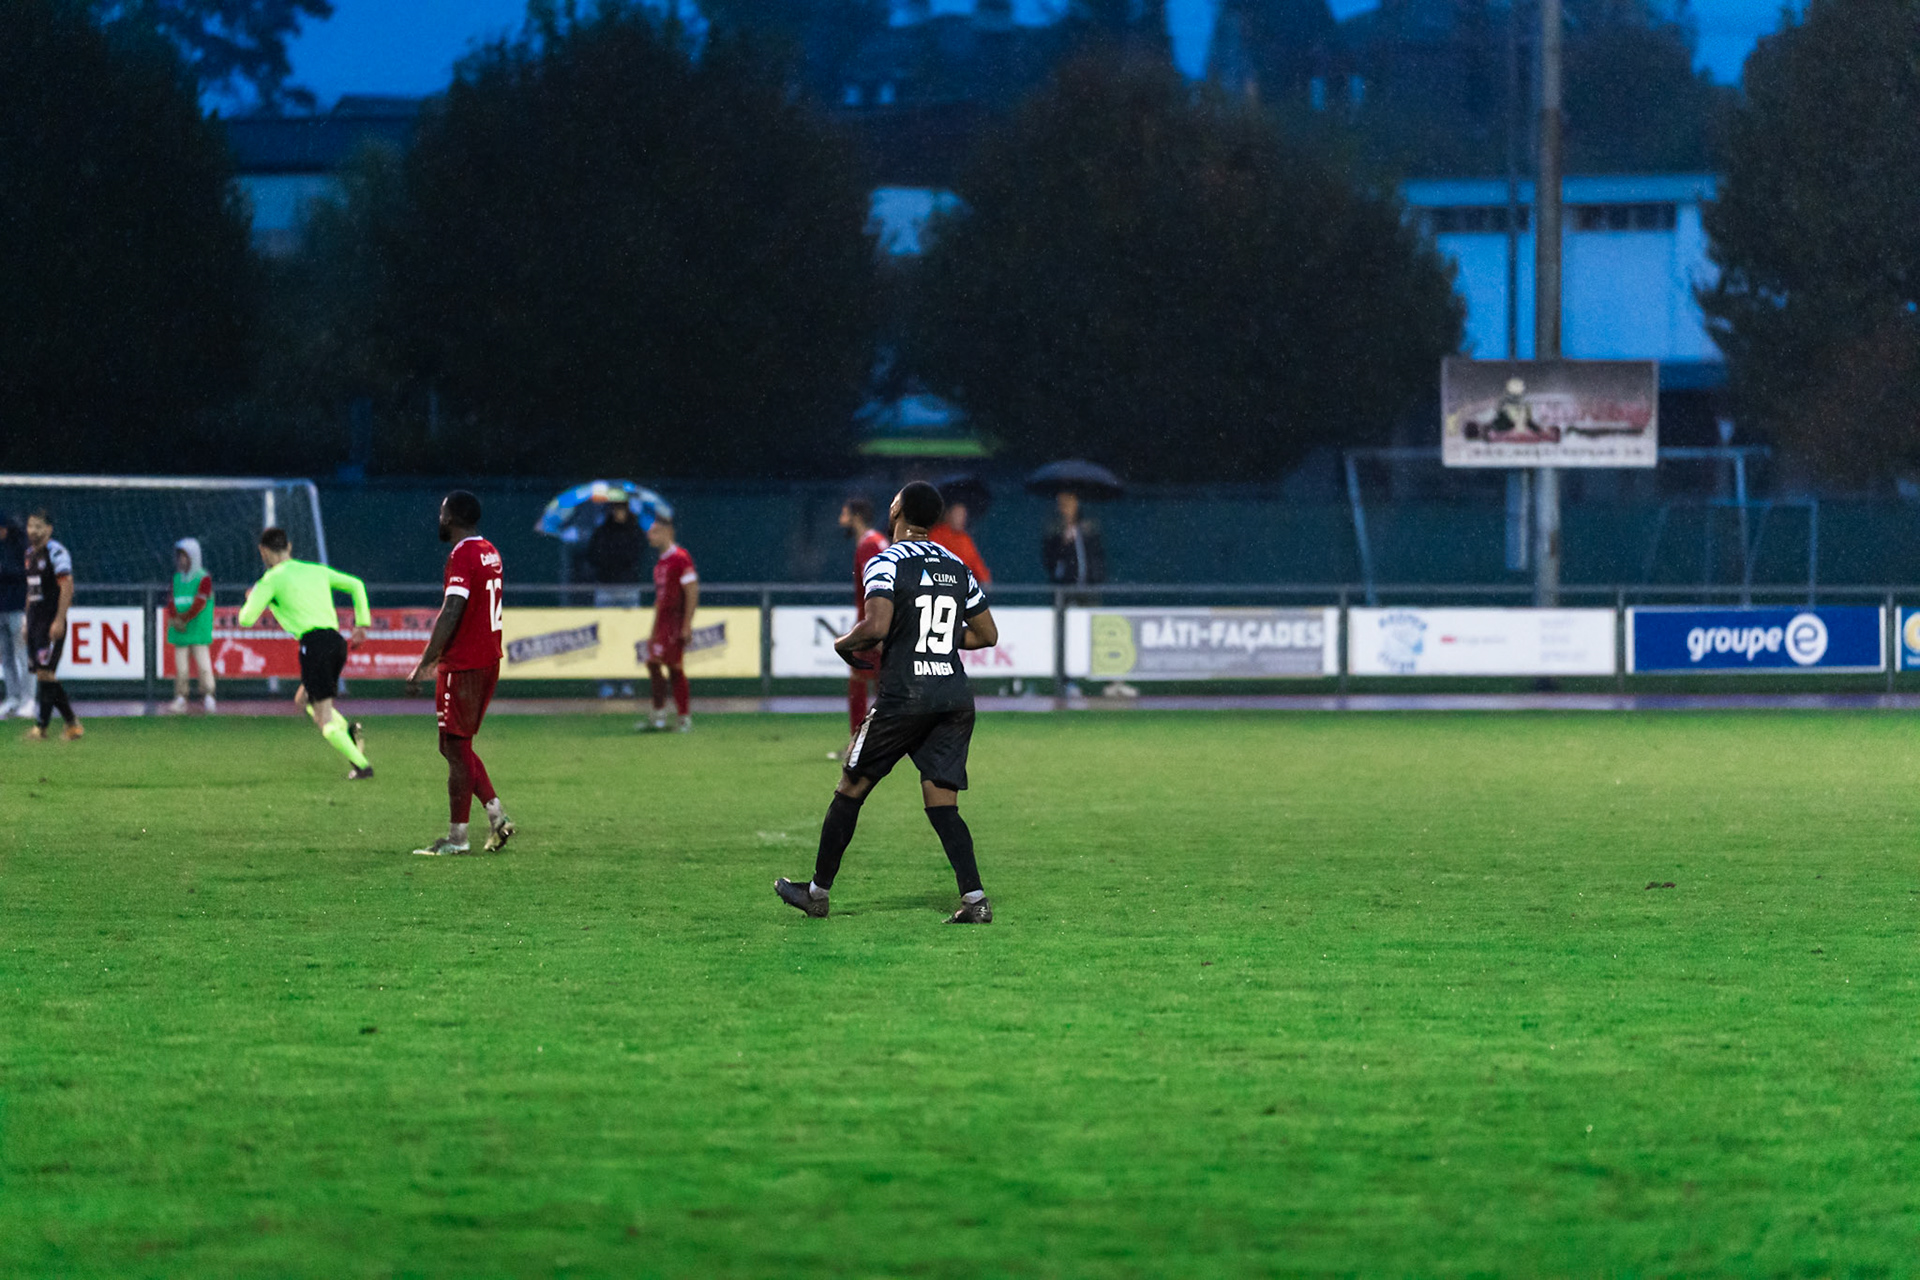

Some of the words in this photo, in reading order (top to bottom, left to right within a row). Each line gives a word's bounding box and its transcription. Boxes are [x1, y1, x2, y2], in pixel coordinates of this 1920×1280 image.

[932, 572, 958, 584] CLIPAL
[914, 594, 957, 655] 19
[1140, 616, 1324, 654] BÂTI-FAÇADES
[1687, 626, 1783, 662] groupe
